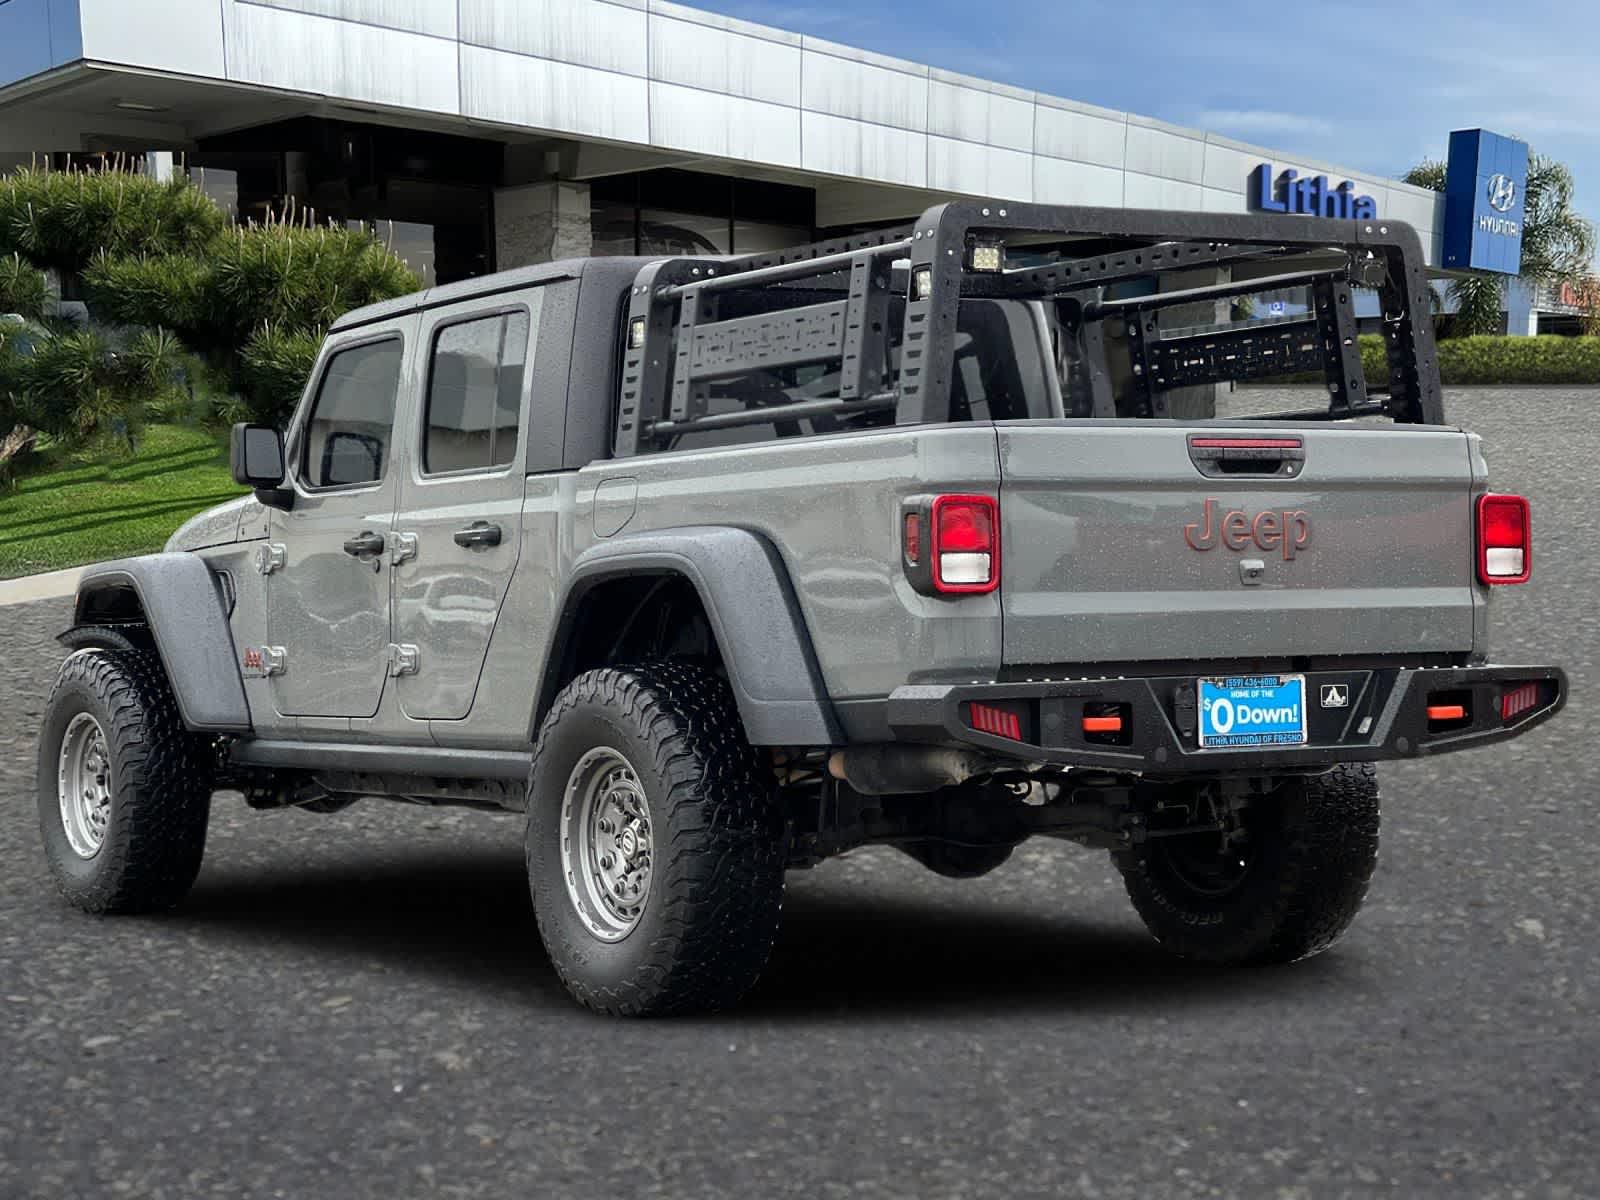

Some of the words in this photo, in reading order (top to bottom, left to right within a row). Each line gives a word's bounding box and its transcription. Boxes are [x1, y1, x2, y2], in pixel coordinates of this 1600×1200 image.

[1257, 163, 1377, 220] Lithia
[1479, 215, 1521, 237] HYUNDAI
[1184, 496, 1312, 561] Jeep
[1231, 690, 1250, 698] HOME
[1251, 690, 1260, 698] OF
[1262, 690, 1274, 698] THE
[1237, 704, 1298, 724] Down!
[1229, 735, 1262, 745] HYUNDAI
[1263, 734, 1273, 742] OF
[1274, 733, 1302, 743] FRESNO
